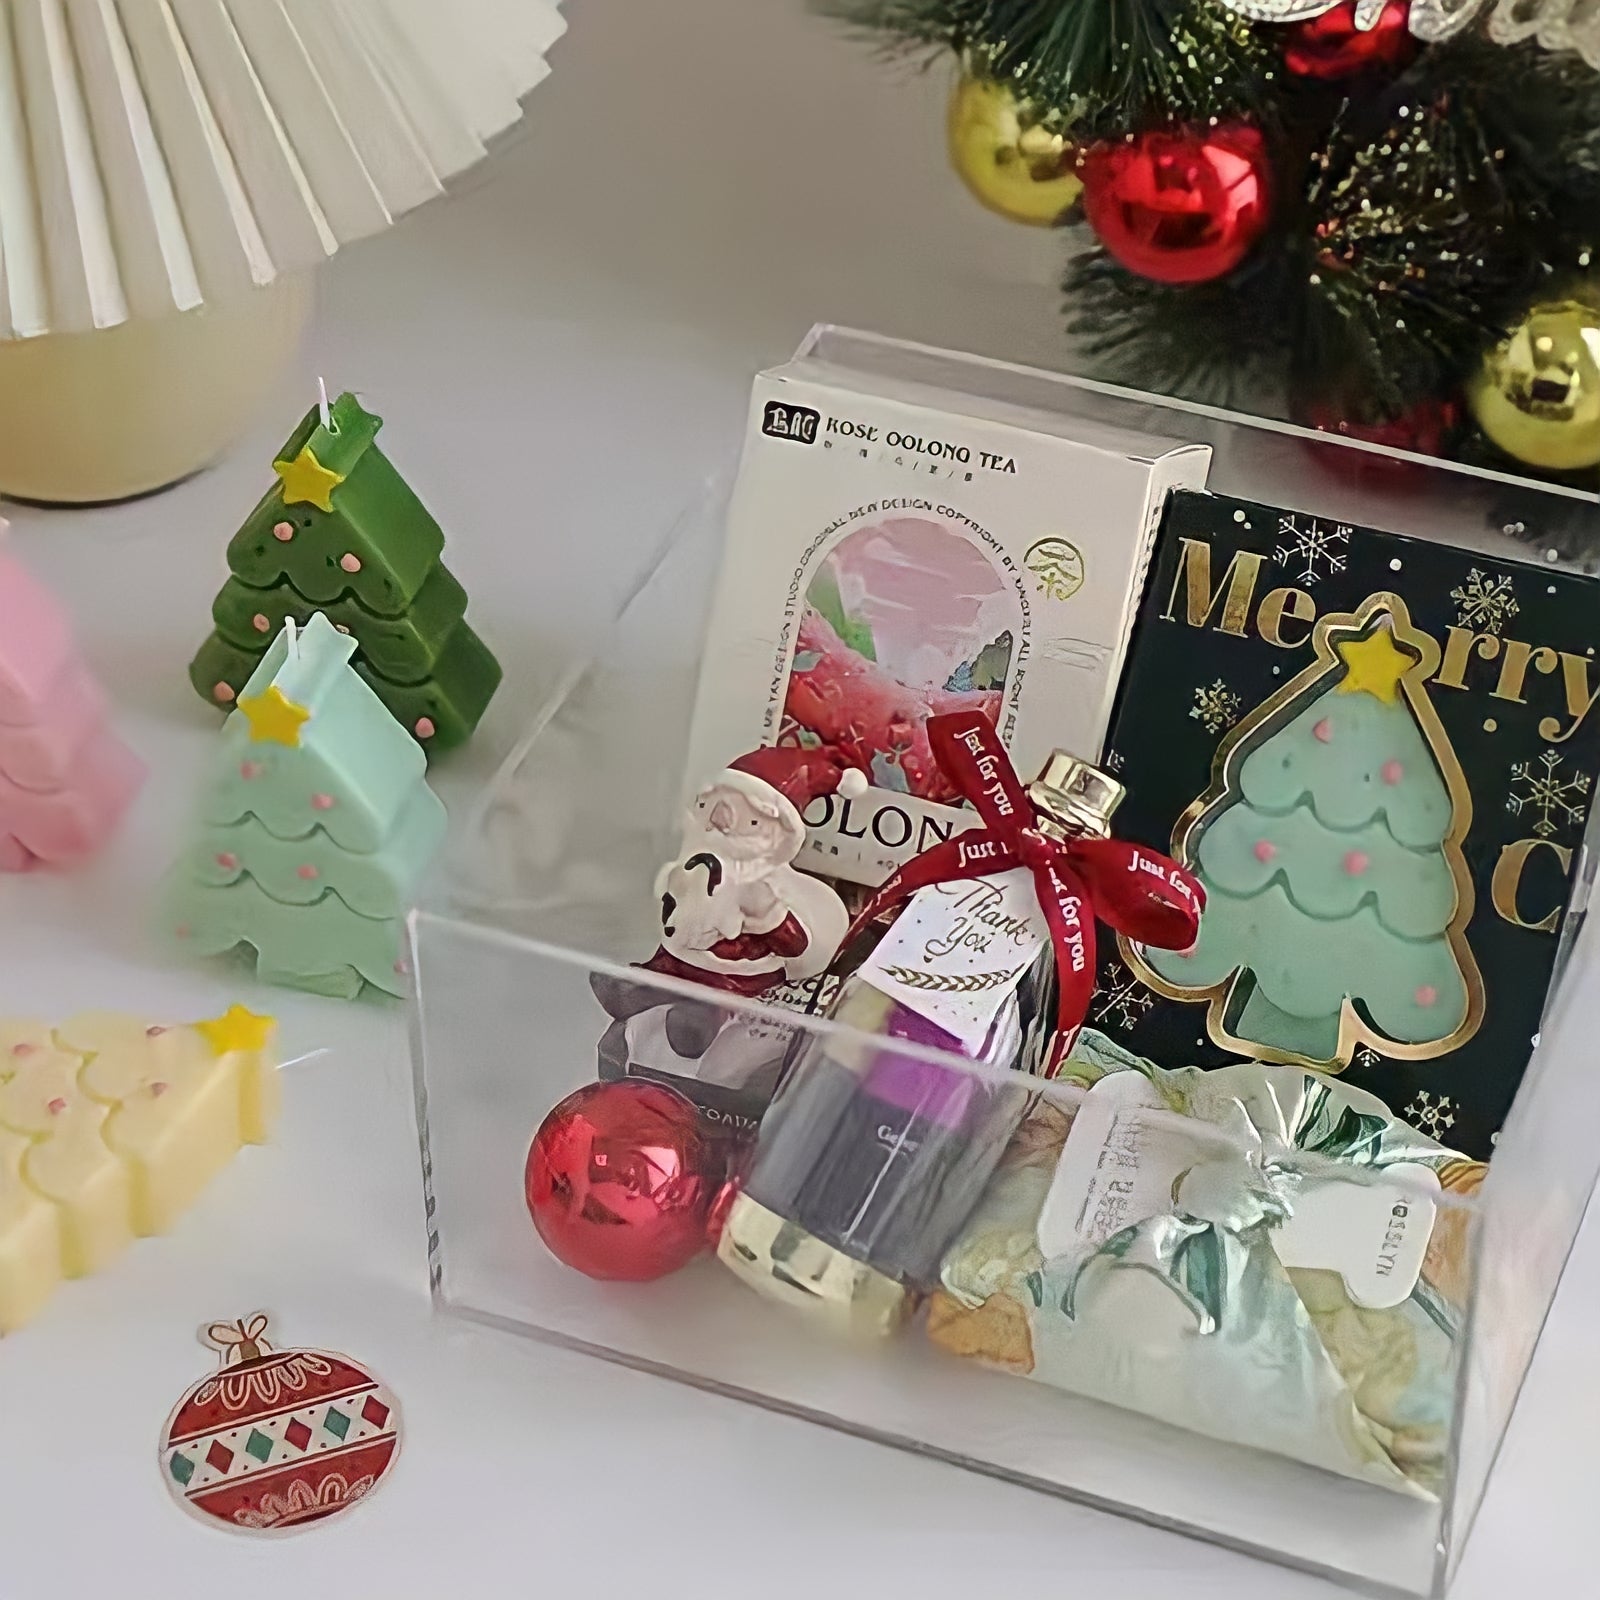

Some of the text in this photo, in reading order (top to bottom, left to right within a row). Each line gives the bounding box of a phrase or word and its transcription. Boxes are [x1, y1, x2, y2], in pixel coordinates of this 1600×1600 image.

[886, 431, 970, 463] OOLONG
[979, 452, 1016, 474] TEA
[983, 782, 1014, 816] you
[934, 877, 1030, 946] Thank
[1058, 896, 1082, 934] for
[924, 916, 995, 963] You
[1063, 935, 1085, 972] you
